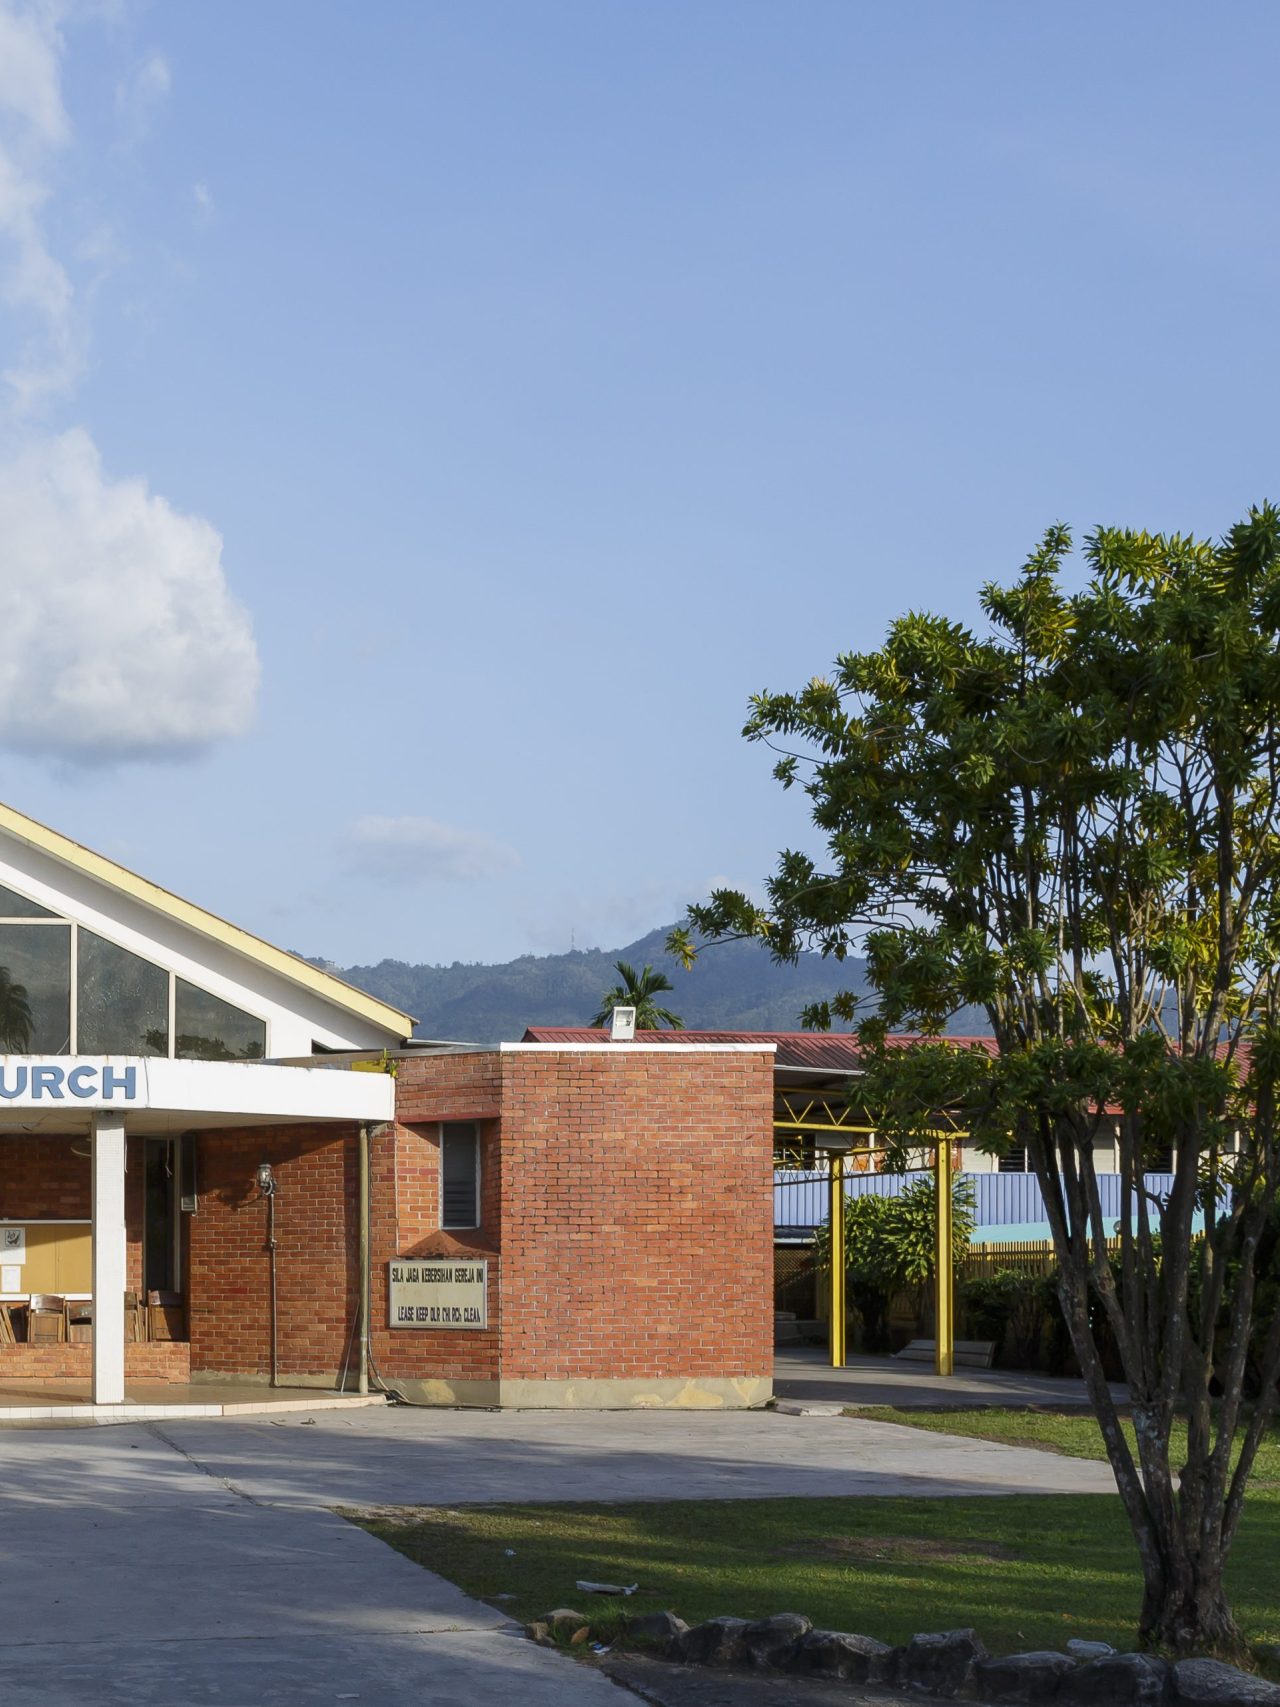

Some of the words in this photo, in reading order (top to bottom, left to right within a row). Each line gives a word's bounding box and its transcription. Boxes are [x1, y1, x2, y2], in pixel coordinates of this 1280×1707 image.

[392, 1268, 404, 1283] SILA
[406, 1268, 419, 1283] JAGA
[421, 1268, 453, 1283] KEBERSIHAN
[454, 1268, 475, 1283] GEREJA
[416, 1307, 429, 1321] KEEP
